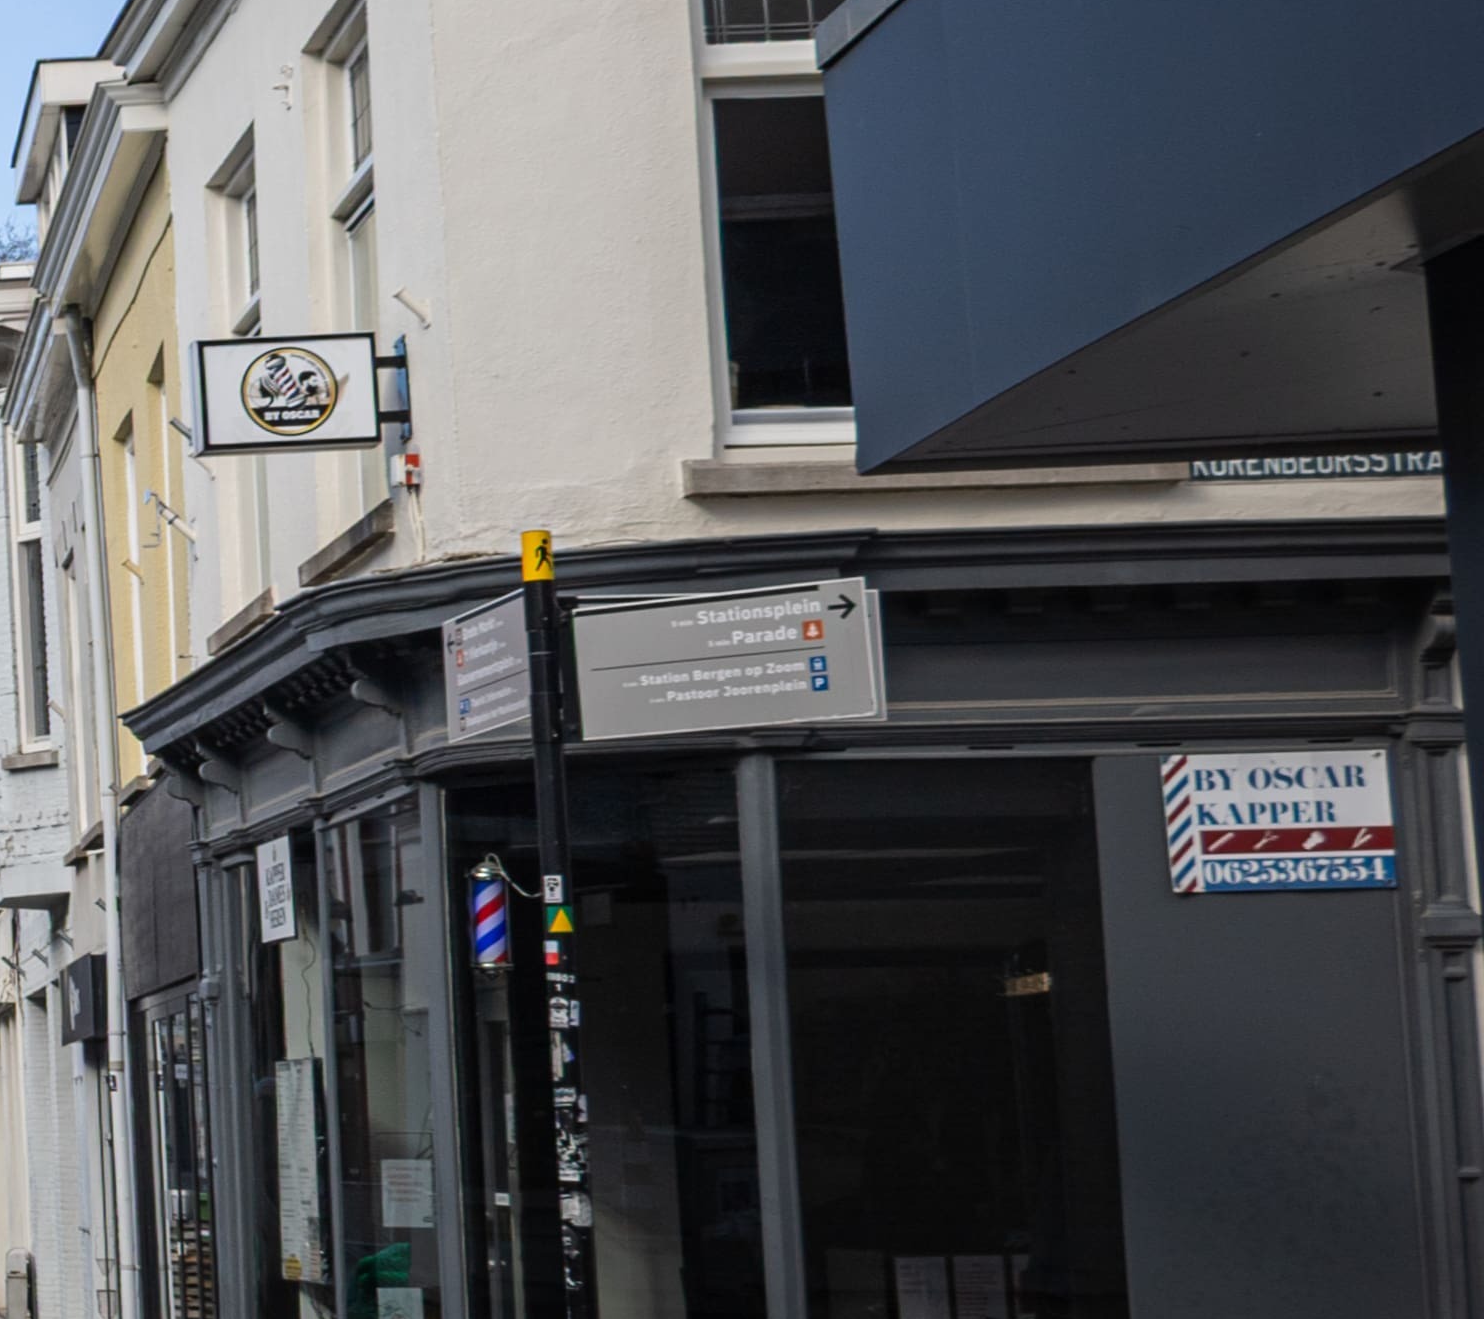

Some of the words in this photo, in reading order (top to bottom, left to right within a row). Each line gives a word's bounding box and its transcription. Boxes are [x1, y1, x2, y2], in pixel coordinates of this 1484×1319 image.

[281, 409, 320, 420] OSCAR
[696, 598, 822, 626] Stationsplein
[731, 625, 798, 646] Parade
[639, 671, 690, 687] Station
[692, 666, 741, 685] Bergen
[744, 666, 763, 680] op
[766, 661, 806, 675] Zoom
[666, 689, 720, 703] Pastoor
[723, 679, 808, 698] Joorenplein
[1194, 769, 1236, 792] BY
[1247, 765, 1366, 791] OSCAR
[1196, 800, 1337, 826] KAPPER
[1204, 856, 1386, 885] 0625367554
